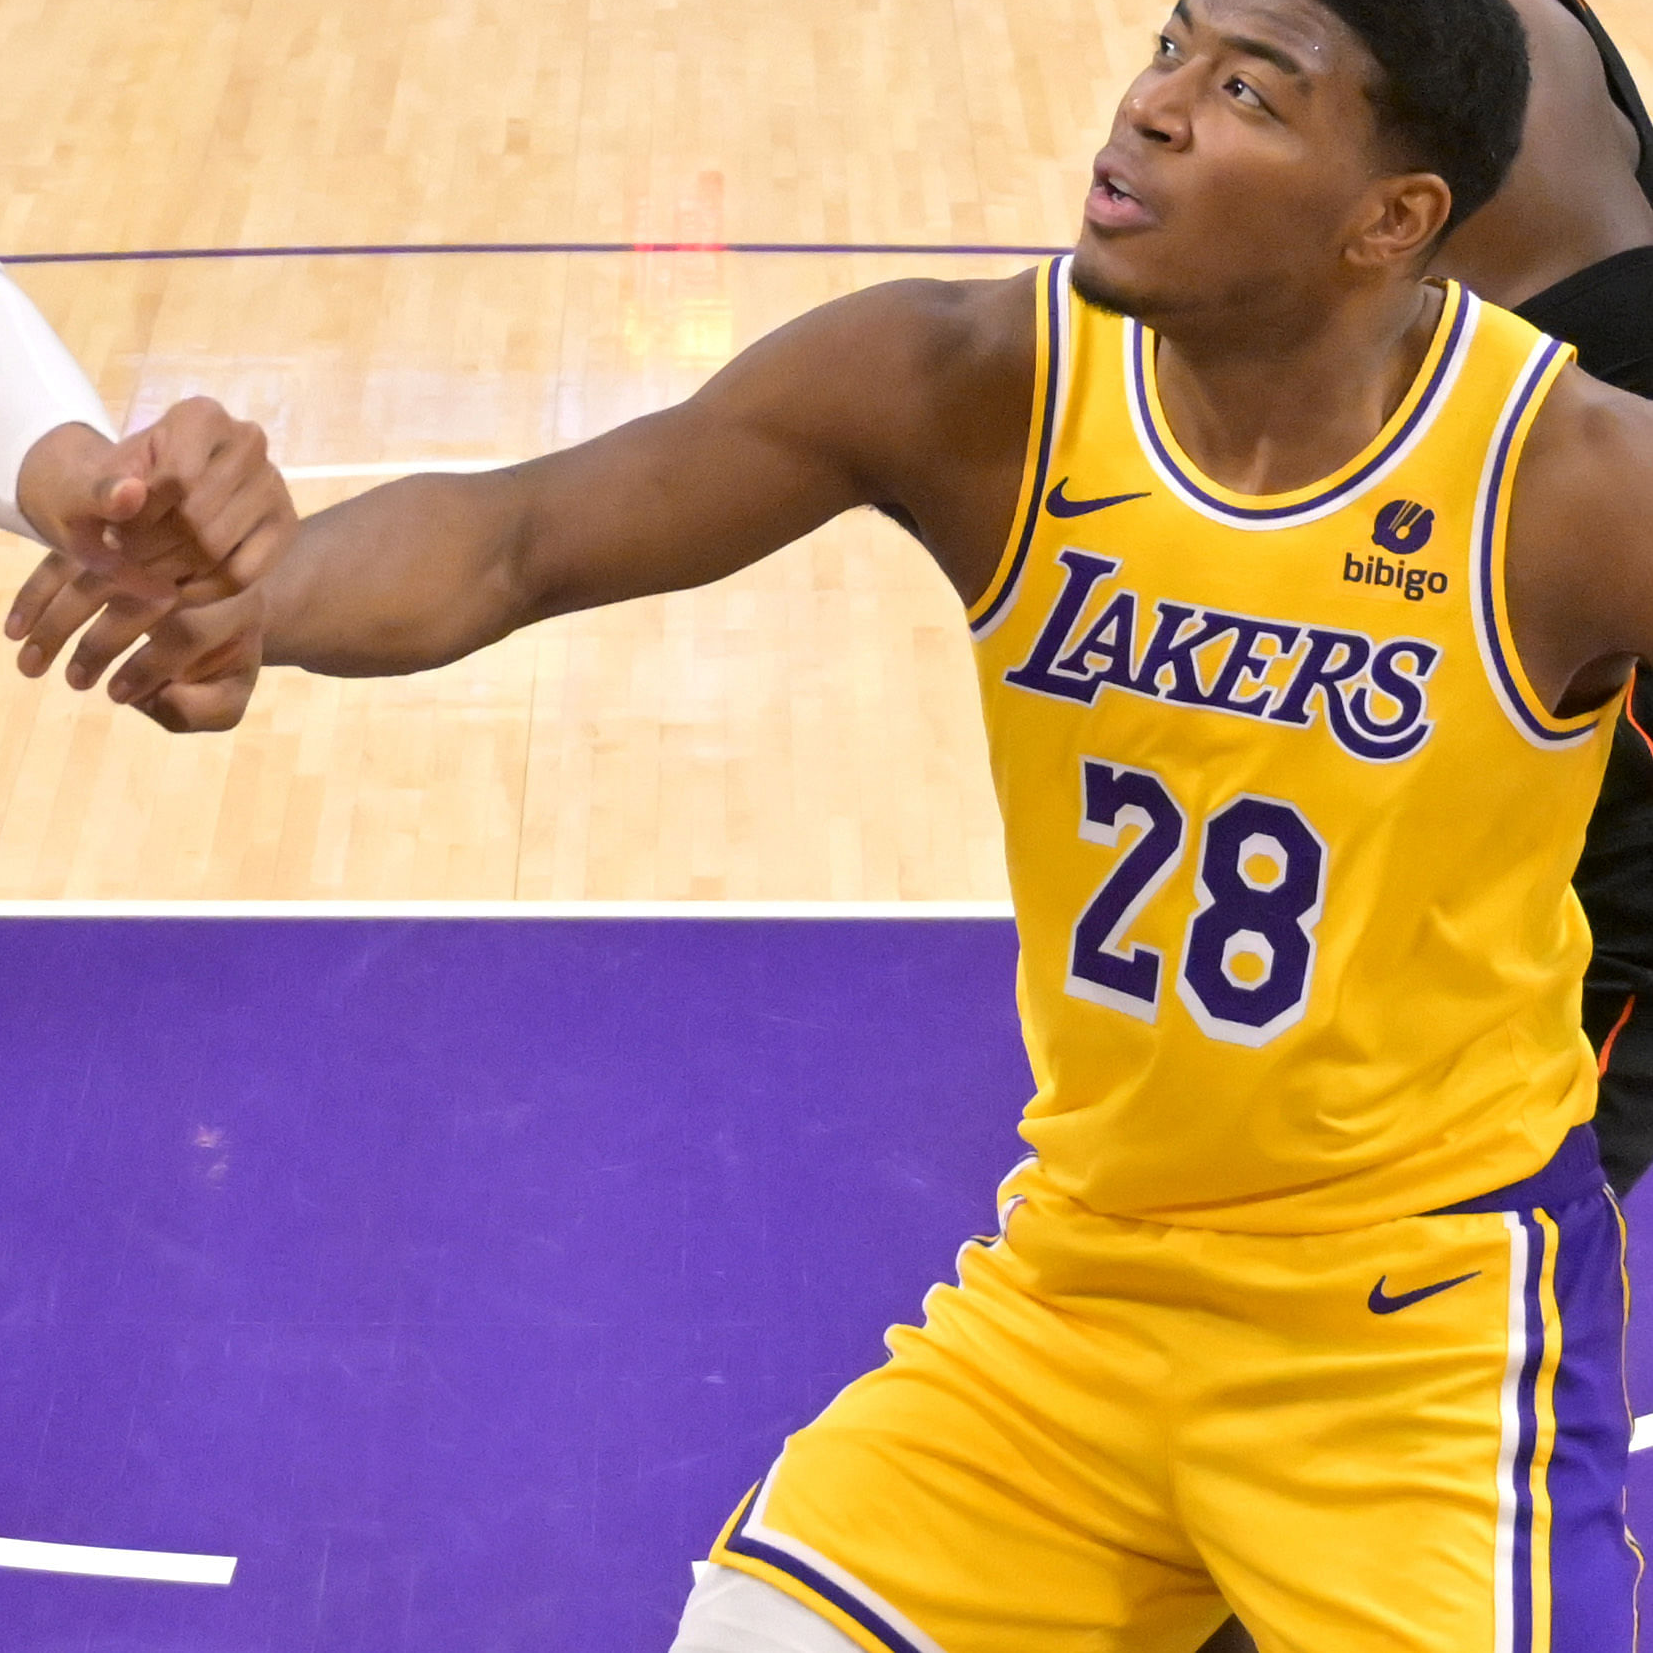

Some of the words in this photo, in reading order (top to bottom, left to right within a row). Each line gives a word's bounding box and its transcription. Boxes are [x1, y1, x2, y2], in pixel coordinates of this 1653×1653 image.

[1002, 544, 1445, 766] LAKERS
[1342, 552, 1449, 601] bibigo
[1063, 753, 1329, 1049] 28
